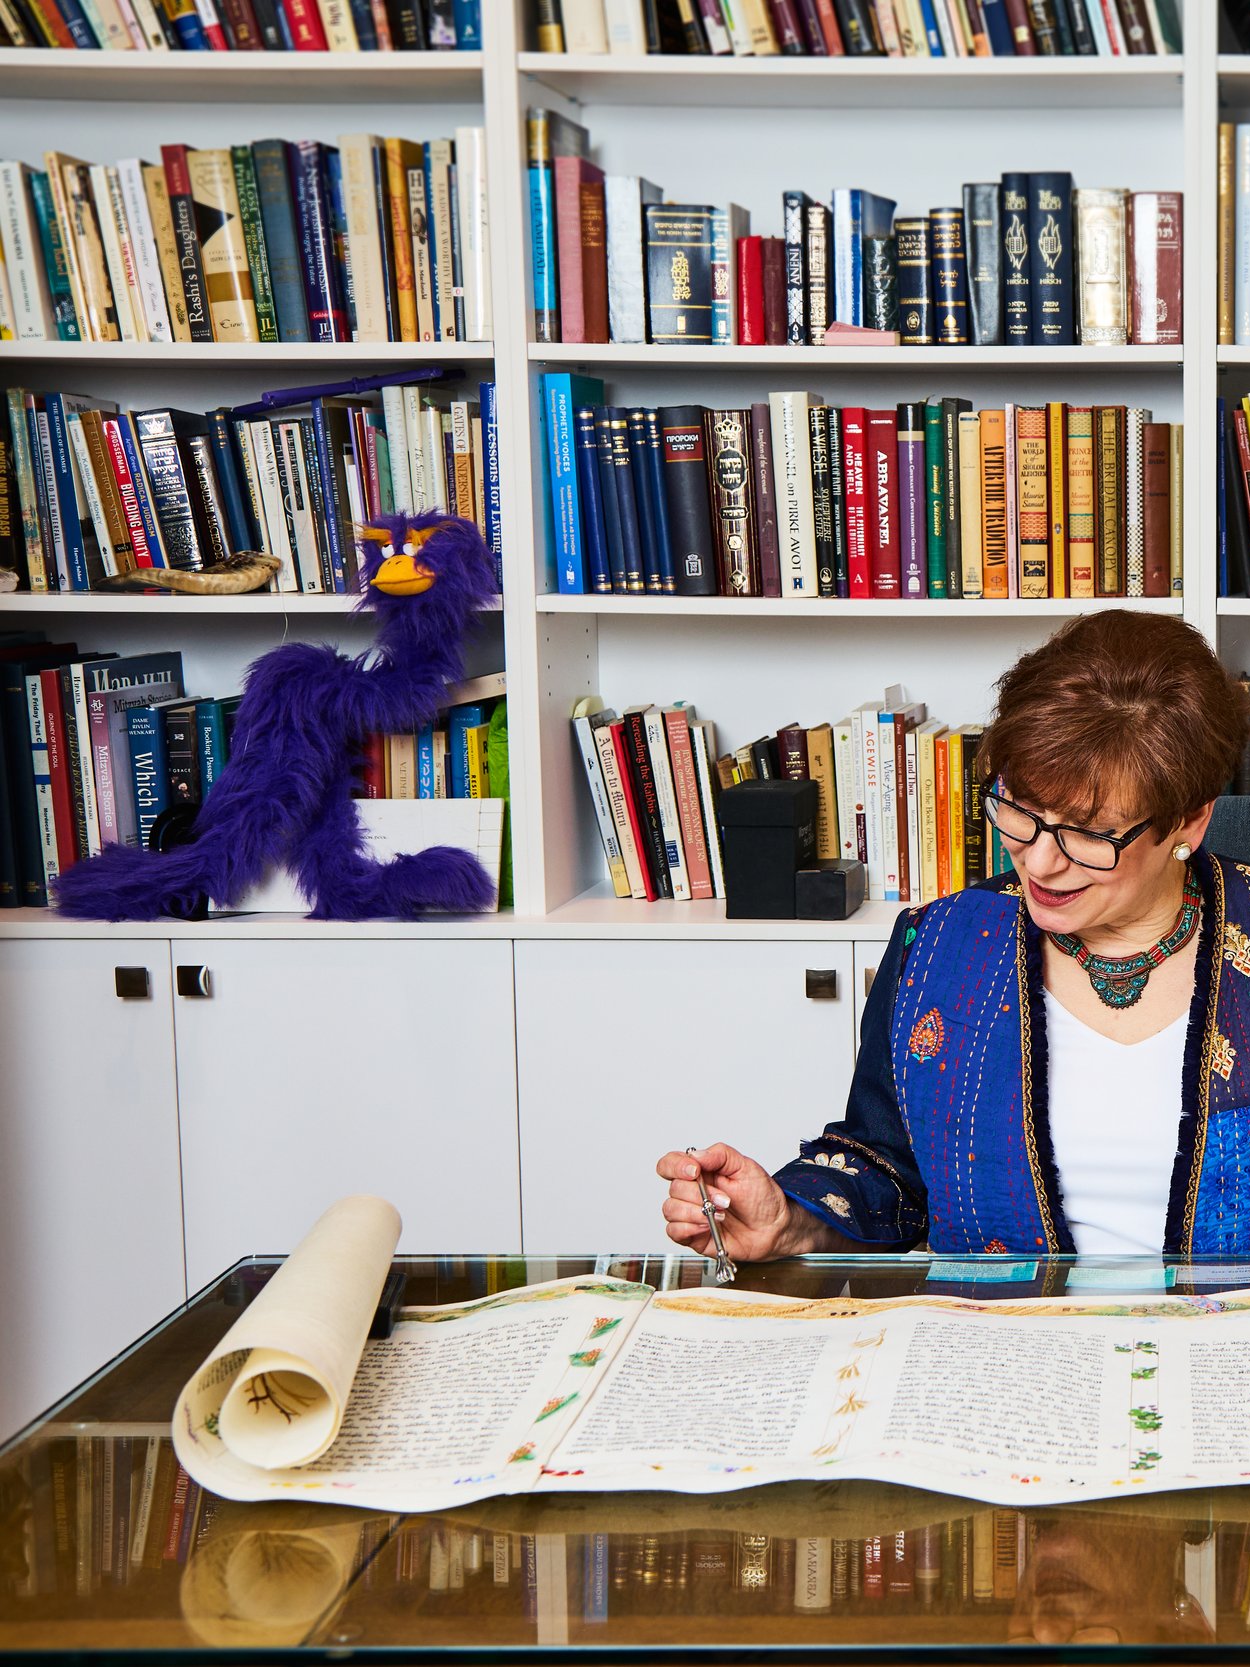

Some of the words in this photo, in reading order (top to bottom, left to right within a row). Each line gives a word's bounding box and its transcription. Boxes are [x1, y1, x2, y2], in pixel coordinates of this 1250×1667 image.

[438, 183, 448, 226] LEADING
[534, 189, 544, 212] THE
[177, 201, 196, 270] Daughters
[536, 219, 545, 275] AMIDAH
[441, 239, 451, 279] WORTHY
[789, 249, 801, 283] ANENI
[186, 275, 204, 323] Rashi's
[444, 282, 452, 302] LIFE
[558, 394, 570, 440] PROPHETIC
[110, 431, 126, 474] PROSSERMAN
[486, 423, 499, 482] Lessons
[666, 434, 699, 443] ПРОРОКИ
[671, 443, 694, 451] נביאים
[1102, 429, 1115, 455] THE
[562, 441, 571, 472] VOICES
[984, 445, 1004, 483] AFTER
[787, 483, 795, 496] on
[854, 453, 863, 495] HEAVEN
[1103, 462, 1116, 512] BRIDAL
[134, 473, 145, 503] RADICAL
[142, 506, 155, 537] JUDAISM
[490, 485, 501, 506] for
[876, 450, 890, 548] ABRAVANEL
[985, 484, 1005, 504] THE
[120, 484, 141, 527] BUILDING
[132, 530, 149, 558] UNITY
[491, 510, 503, 554] Living
[788, 500, 799, 534] PIRKE
[790, 537, 801, 571] AVOT
[985, 508, 1007, 566] TRADITION
[1104, 518, 1117, 573] CANOPY
[31, 698, 40, 718] Friday
[33, 719, 42, 736] That
[204, 727, 213, 755] Booking
[599, 737, 611, 747] A
[631, 717, 647, 764] Rereading
[98, 746, 109, 789] Mitzvah
[206, 757, 214, 783] Passage
[639, 765, 651, 780] the
[681, 749, 695, 780] JEWISH
[865, 730, 877, 787] AGEWISE
[883, 760, 894, 782] Wise
[907, 759, 915, 774] and
[134, 752, 159, 808] Which
[882, 782, 896, 812] Aging
[907, 776, 916, 796] Thou
[925, 779, 933, 790] On
[102, 791, 114, 827] Stories
[642, 782, 658, 814] Rabbis
[685, 780, 700, 829] AMERICAN
[925, 792, 933, 804] the
[971, 784, 981, 820] Heschel
[925, 806, 934, 825] Book
[926, 827, 934, 835] of
[690, 829, 707, 863] POETRY
[925, 837, 935, 863] Psalms
